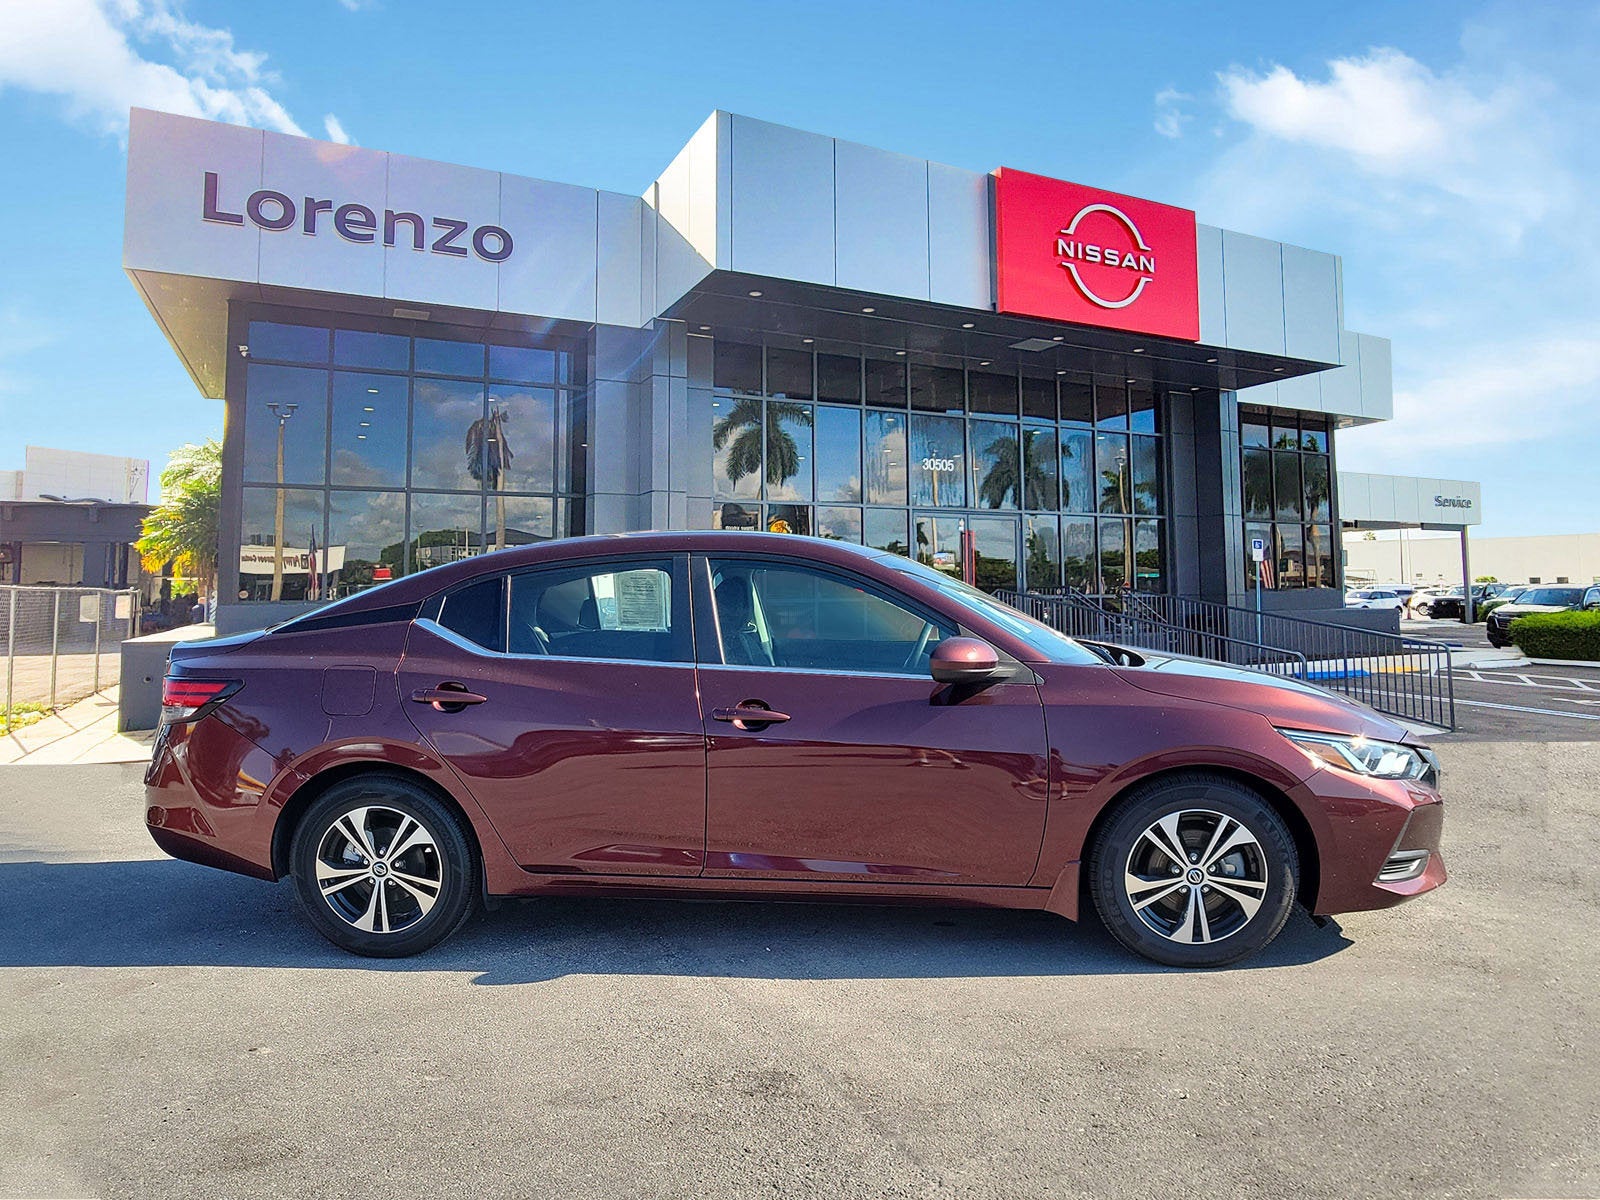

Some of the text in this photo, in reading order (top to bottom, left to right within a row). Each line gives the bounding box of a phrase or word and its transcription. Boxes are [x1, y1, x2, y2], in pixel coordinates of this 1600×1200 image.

[202, 170, 514, 262] Lorenzo
[1057, 238, 1155, 273] NISSAN
[922, 458, 955, 472] 30505
[1434, 495, 1472, 508] Service
